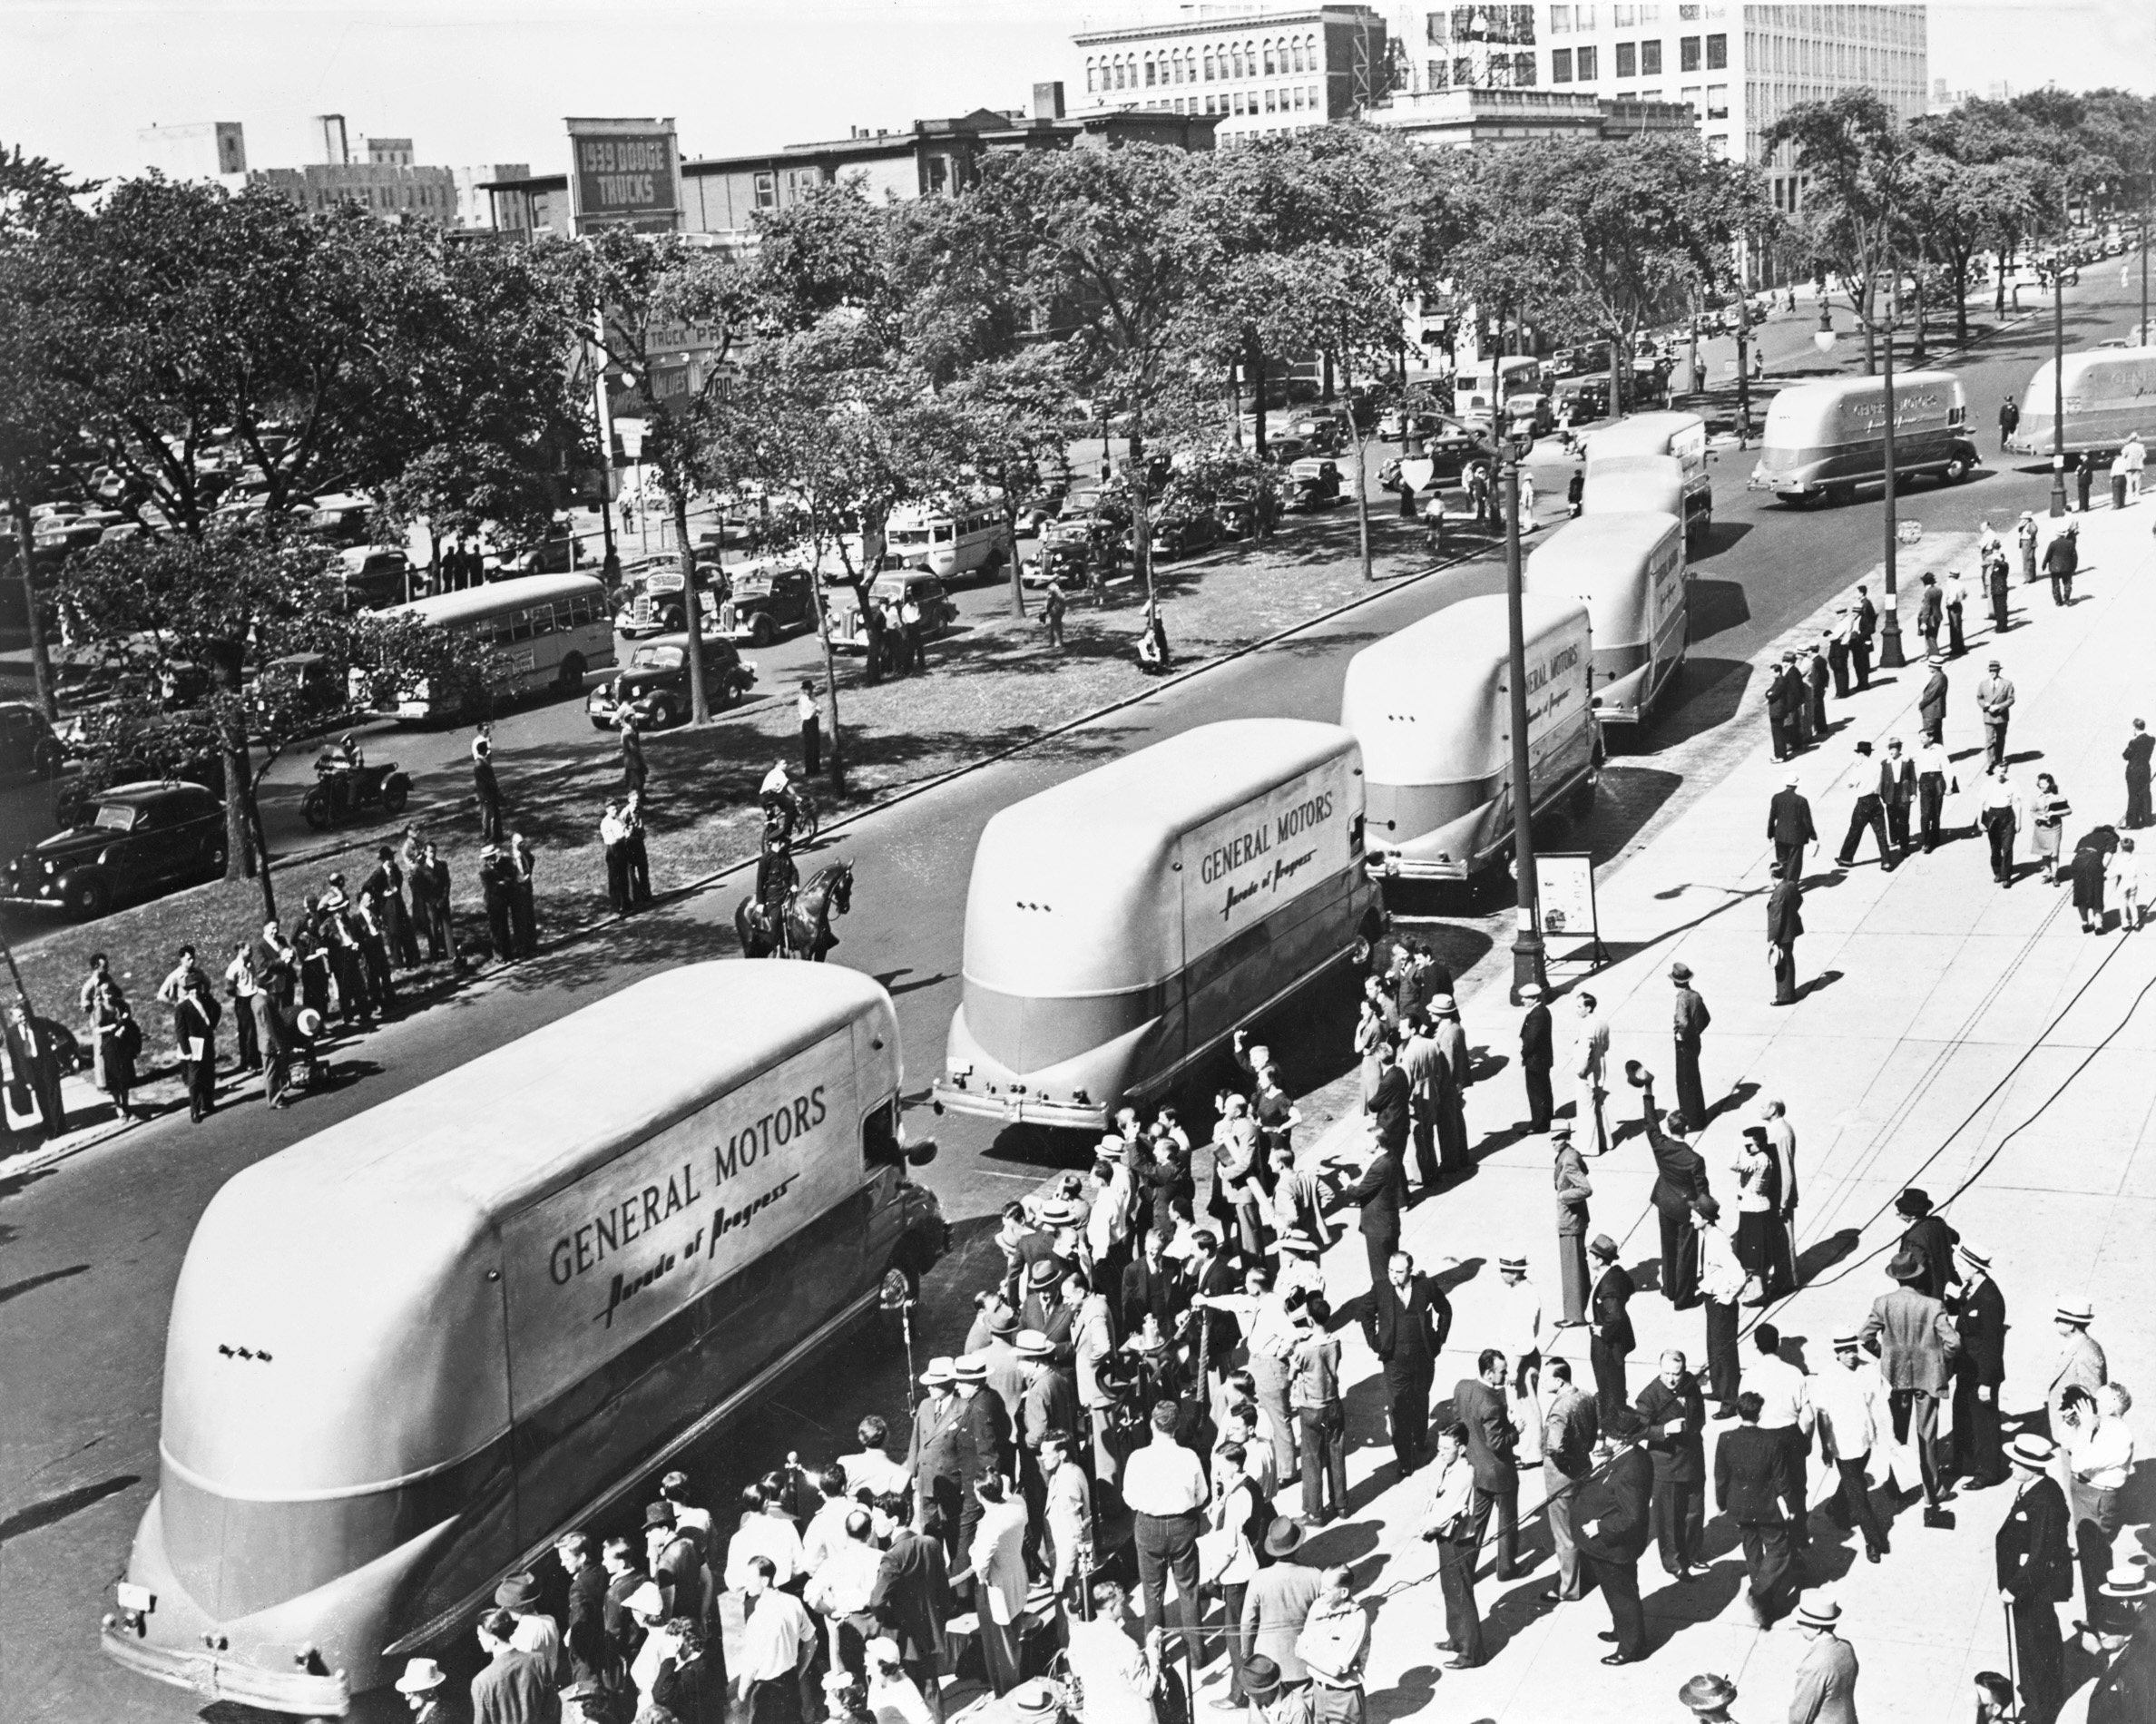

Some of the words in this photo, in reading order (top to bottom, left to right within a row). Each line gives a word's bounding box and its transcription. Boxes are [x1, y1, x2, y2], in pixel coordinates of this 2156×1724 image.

[581, 142, 615, 171] 1939
[617, 142, 664, 171] DODGE
[597, 174, 654, 204] TRUCKS
[651, 329, 687, 348] TRUCK
[1201, 824, 1271, 885] GENERAL
[1277, 790, 1333, 845] MOTORS
[1219, 881, 1259, 922] Parade
[1261, 870, 1272, 889] of
[1272, 848, 1318, 894] Progress
[549, 1163, 701, 1285] GENERAL
[714, 1084, 827, 1187] MOTORS
[593, 1253, 676, 1330] Parade
[684, 1227, 705, 1259] of
[708, 1172, 801, 1260] Progress
